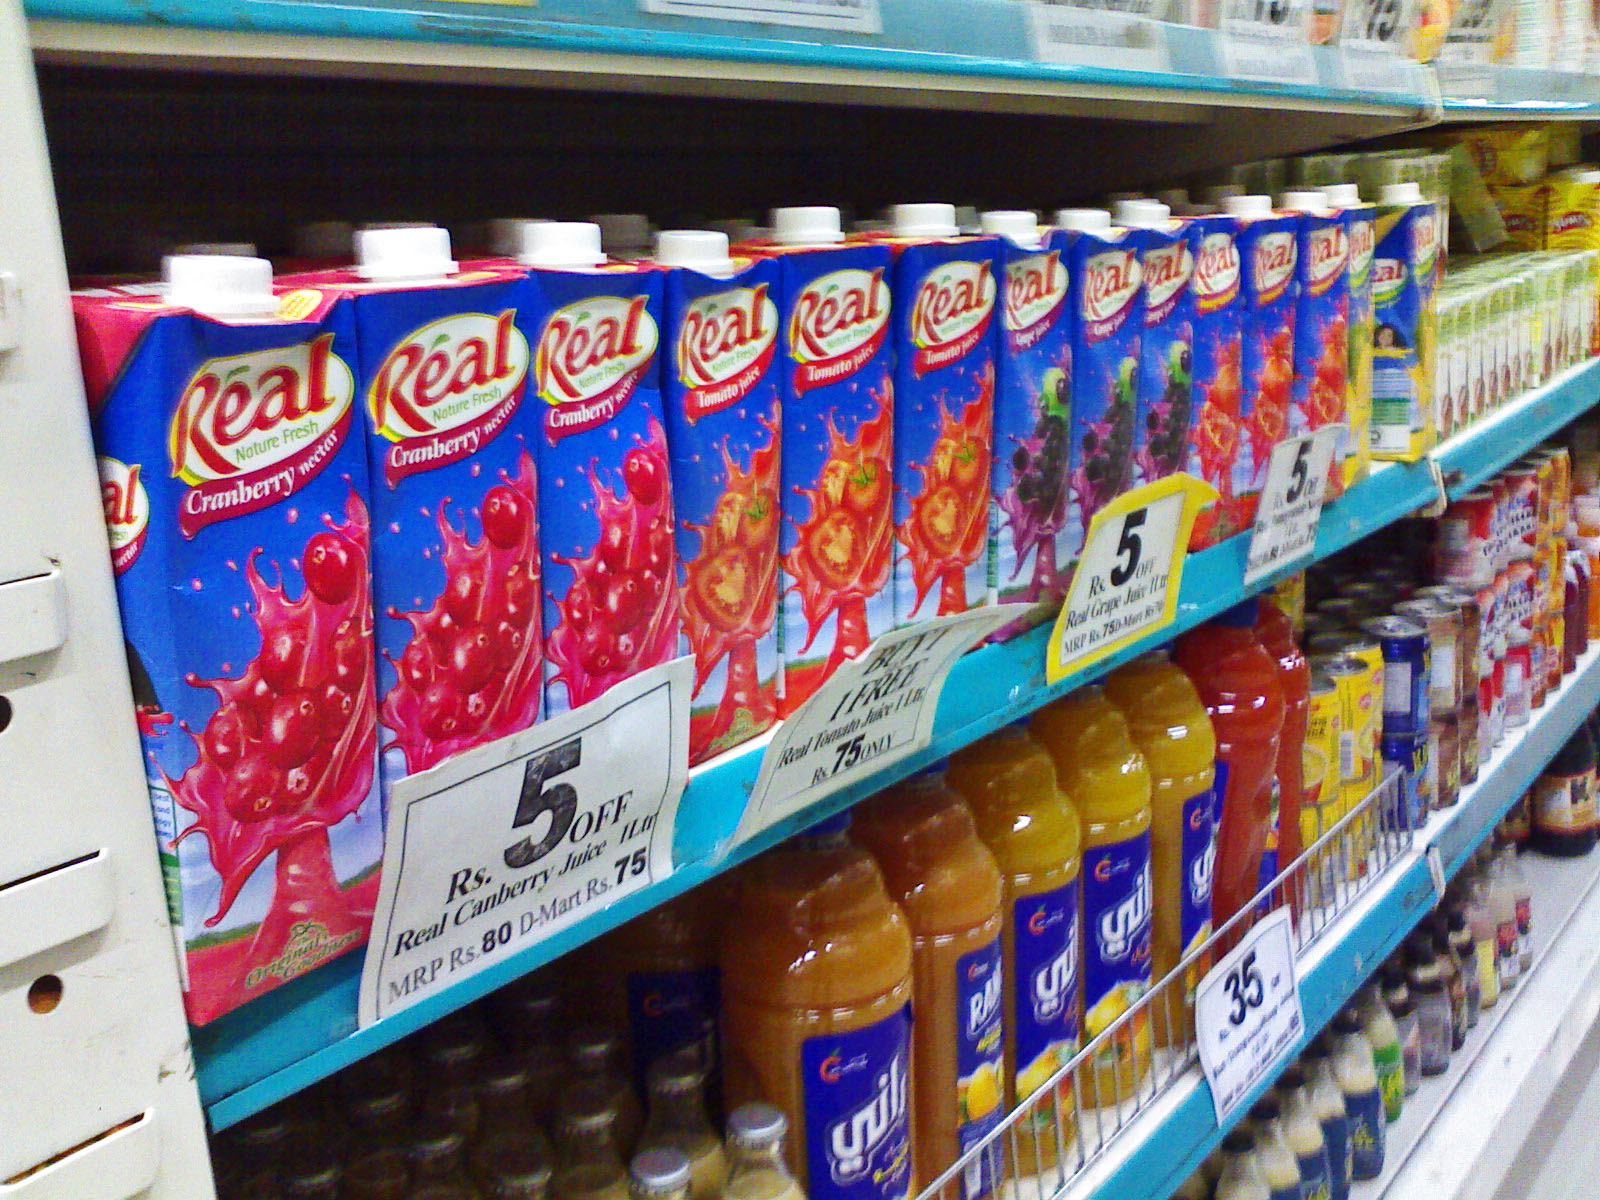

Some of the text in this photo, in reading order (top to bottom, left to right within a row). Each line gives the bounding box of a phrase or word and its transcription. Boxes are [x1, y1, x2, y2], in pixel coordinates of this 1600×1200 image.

[697, 366, 760, 408] Tomato juice
[808, 344, 875, 382] Tomato juice
[390, 397, 516, 468] Cranberry nectar
[432, 386, 502, 424] Nature Fresh
[549, 400, 614, 428] Cranberry
[186, 429, 340, 516] Cranberry nectar
[235, 420, 320, 463] Nature Fresh
[1287, 439, 1314, 503] 5
[102, 464, 141, 525] al
[1110, 507, 1148, 586] 5
[1090, 595, 1122, 618] Grape
[1064, 633, 1087, 653] MRP
[846, 656, 930, 715] FREE
[778, 736, 813, 768] Real
[814, 718, 861, 752] Tomato
[861, 703, 895, 728] Juice
[831, 733, 866, 775] 75
[504, 736, 582, 870] 5
[445, 789, 633, 906] Rs. OFF
[393, 913, 447, 958] Real
[454, 868, 554, 926] Canberry
[558, 838, 607, 876] Juice
[387, 959, 444, 1006] MRP
[519, 892, 583, 937] D-Mart
[1224, 950, 1264, 1026] 35
